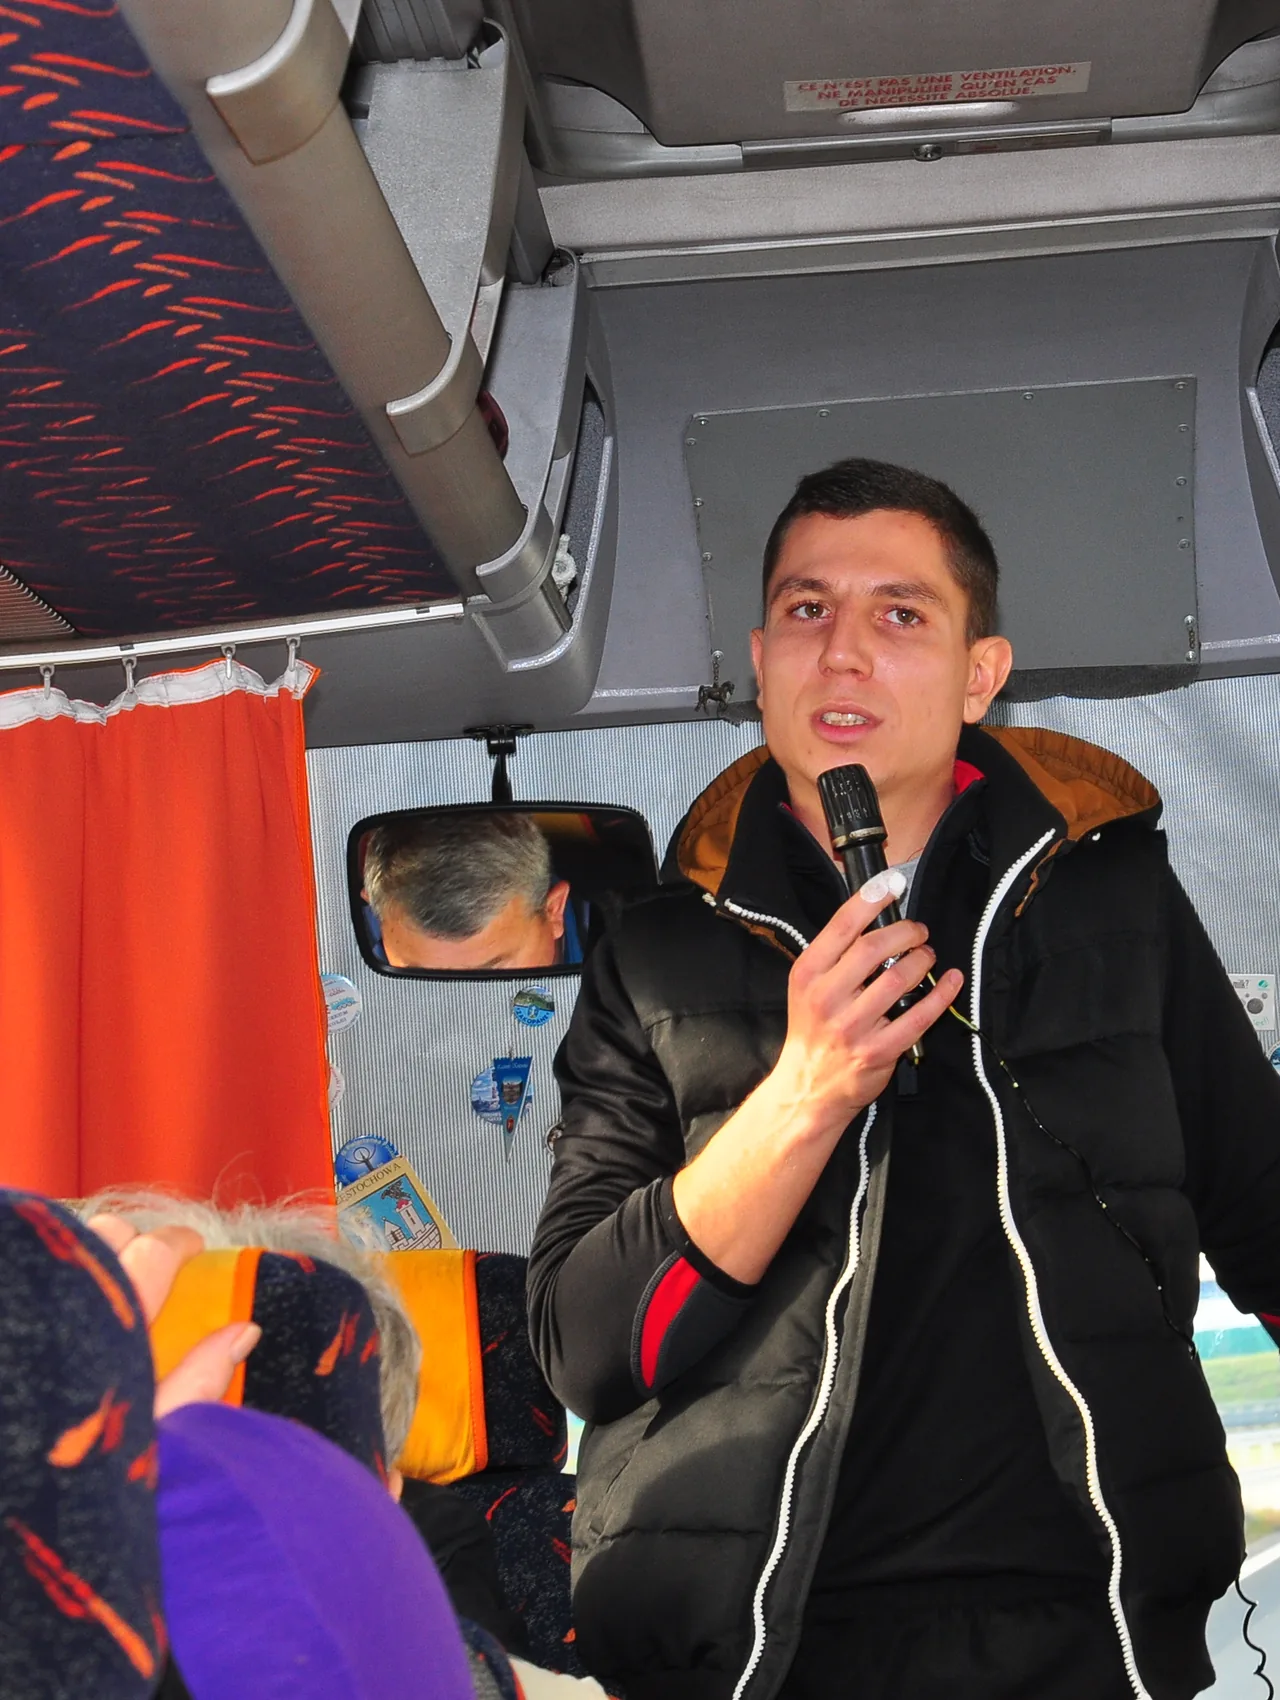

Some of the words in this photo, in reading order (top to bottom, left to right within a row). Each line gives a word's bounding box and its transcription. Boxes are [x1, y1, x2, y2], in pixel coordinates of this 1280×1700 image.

[798, 82, 817, 92] CE
[824, 79, 873, 91] N'EST
[879, 76, 911, 87] PAS
[917, 74, 953, 85] UNE
[960, 65, 1077, 82] VENTILATION.
[818, 91, 841, 100] NE
[960, 79, 1017, 91] QU'EN
[1022, 75, 1057, 86] CAS
[839, 99, 859, 107] DE
[865, 93, 948, 105] NECESSITE
[955, 86, 1035, 100] ABSOLUE.
